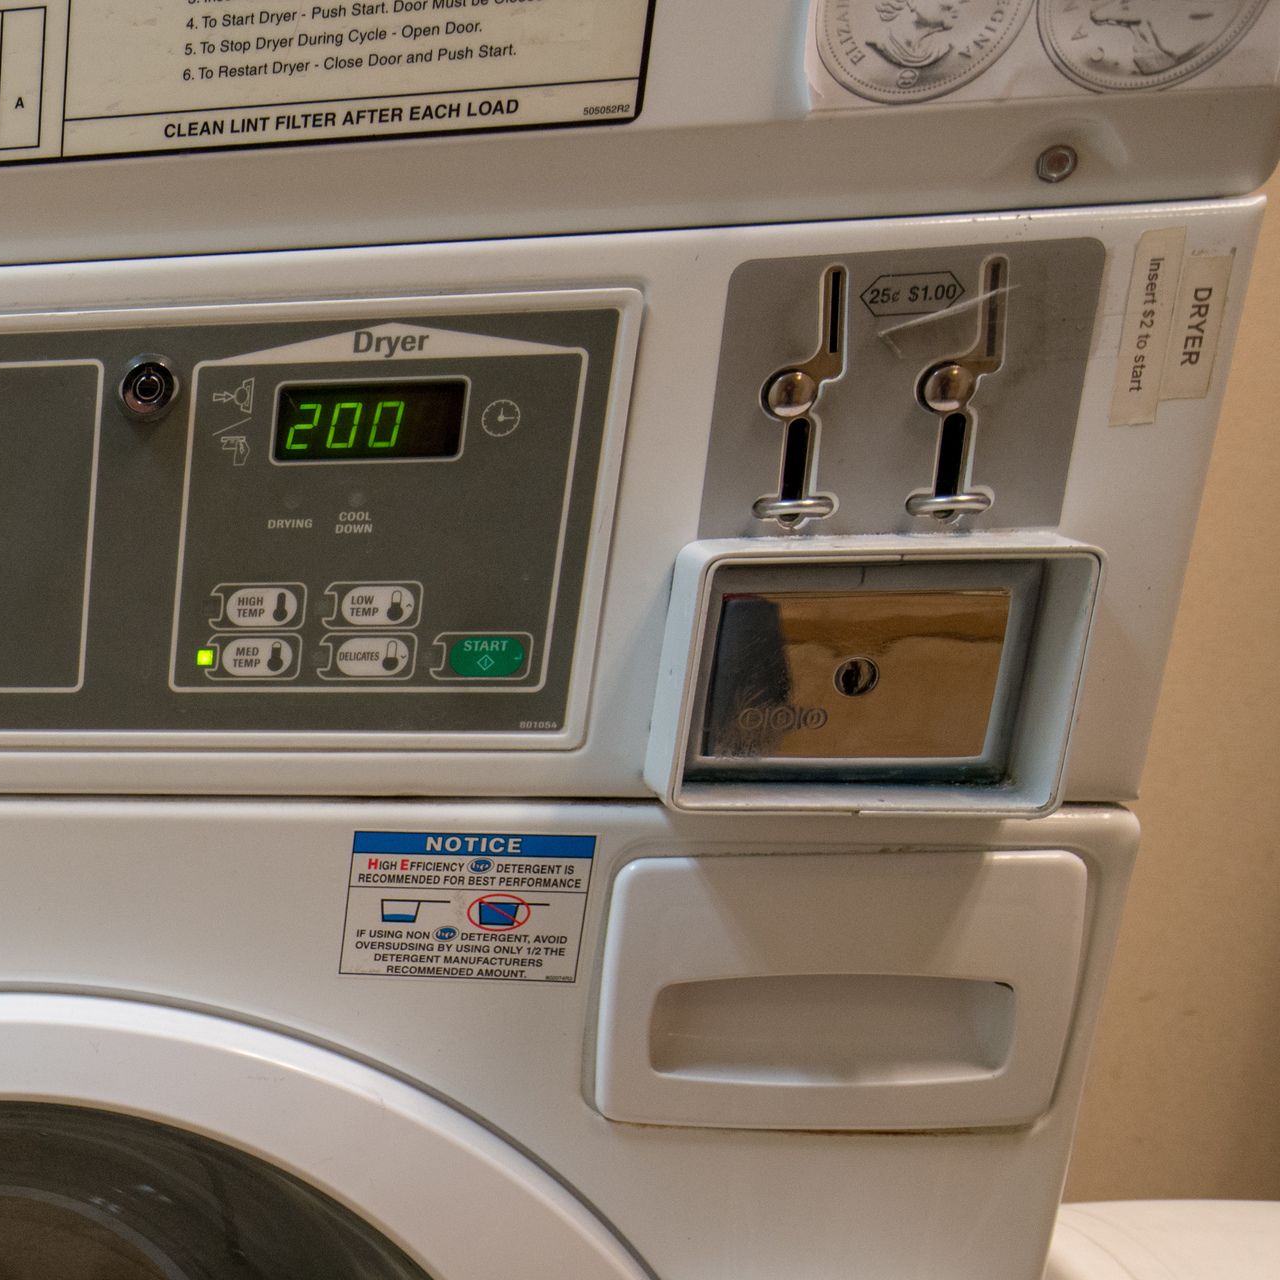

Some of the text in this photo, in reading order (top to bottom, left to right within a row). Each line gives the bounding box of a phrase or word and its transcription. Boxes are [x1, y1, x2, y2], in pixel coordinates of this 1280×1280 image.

[14, 96, 25, 109] A
[164, 99, 519, 138] CLEAN LINT FILTER AFTER EACH LOAD
[908, 283, 957, 303] $1.00
[1128, 257, 1165, 393] Insert $2 to start
[1180, 287, 1213, 366] DRYER
[353, 330, 430, 359] Dryer
[285, 401, 405, 450] 200
[267, 518, 313, 529] DRYING
[338, 511, 372, 522] COOL
[335, 523, 373, 534] DOWN
[237, 596, 264, 606] HIGH
[351, 595, 375, 605] LOW
[236, 608, 266, 618] TEMP
[350, 607, 379, 617] TEMP
[235, 646, 260, 657] MED
[463, 640, 509, 652] START
[233, 658, 261, 668] TEMP
[338, 651, 380, 662] DELICATES
[425, 836, 522, 853] NOTICE
[367, 858, 575, 875] HIGH EFFICIENCY DETERGENT IS
[358, 873, 582, 889] RECOMMENDED FOR BEST PERFORMANCE
[356, 929, 568, 945] IF USING NON DETERGENT, AVOID
[355, 940, 566, 957] OVERSUDSING BY USING ONLY 1/2 THE
[373, 953, 544, 968] DETERGENT MANUFACTURERS
[386, 965, 527, 979] RECOMMENDED AMOUNT.
